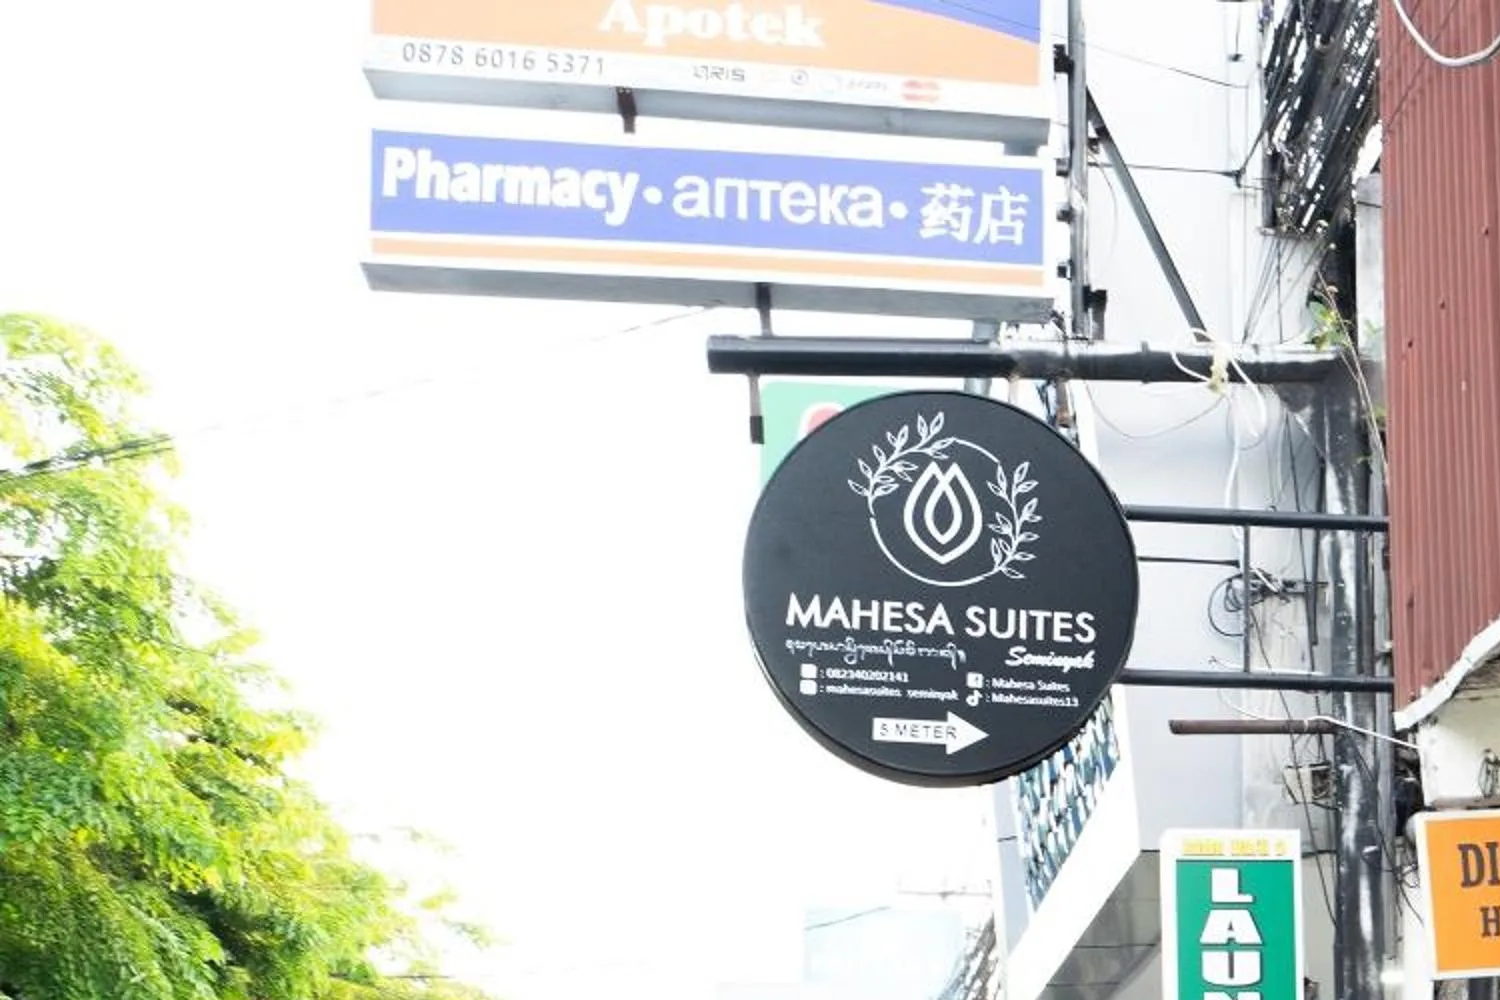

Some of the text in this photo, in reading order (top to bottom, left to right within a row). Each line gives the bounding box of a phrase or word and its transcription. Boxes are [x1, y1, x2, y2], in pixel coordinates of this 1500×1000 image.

[597, 0, 825, 47] Apotek
[402, 42, 606, 77] 0878 6016 5371
[382, 147, 639, 225] Pharmacy
[673, 173, 885, 228] аптека
[919, 180, 1028, 245] 药店
[785, 593, 1096, 643] MAHESA SUITES
[894, 723, 958, 740] METER
